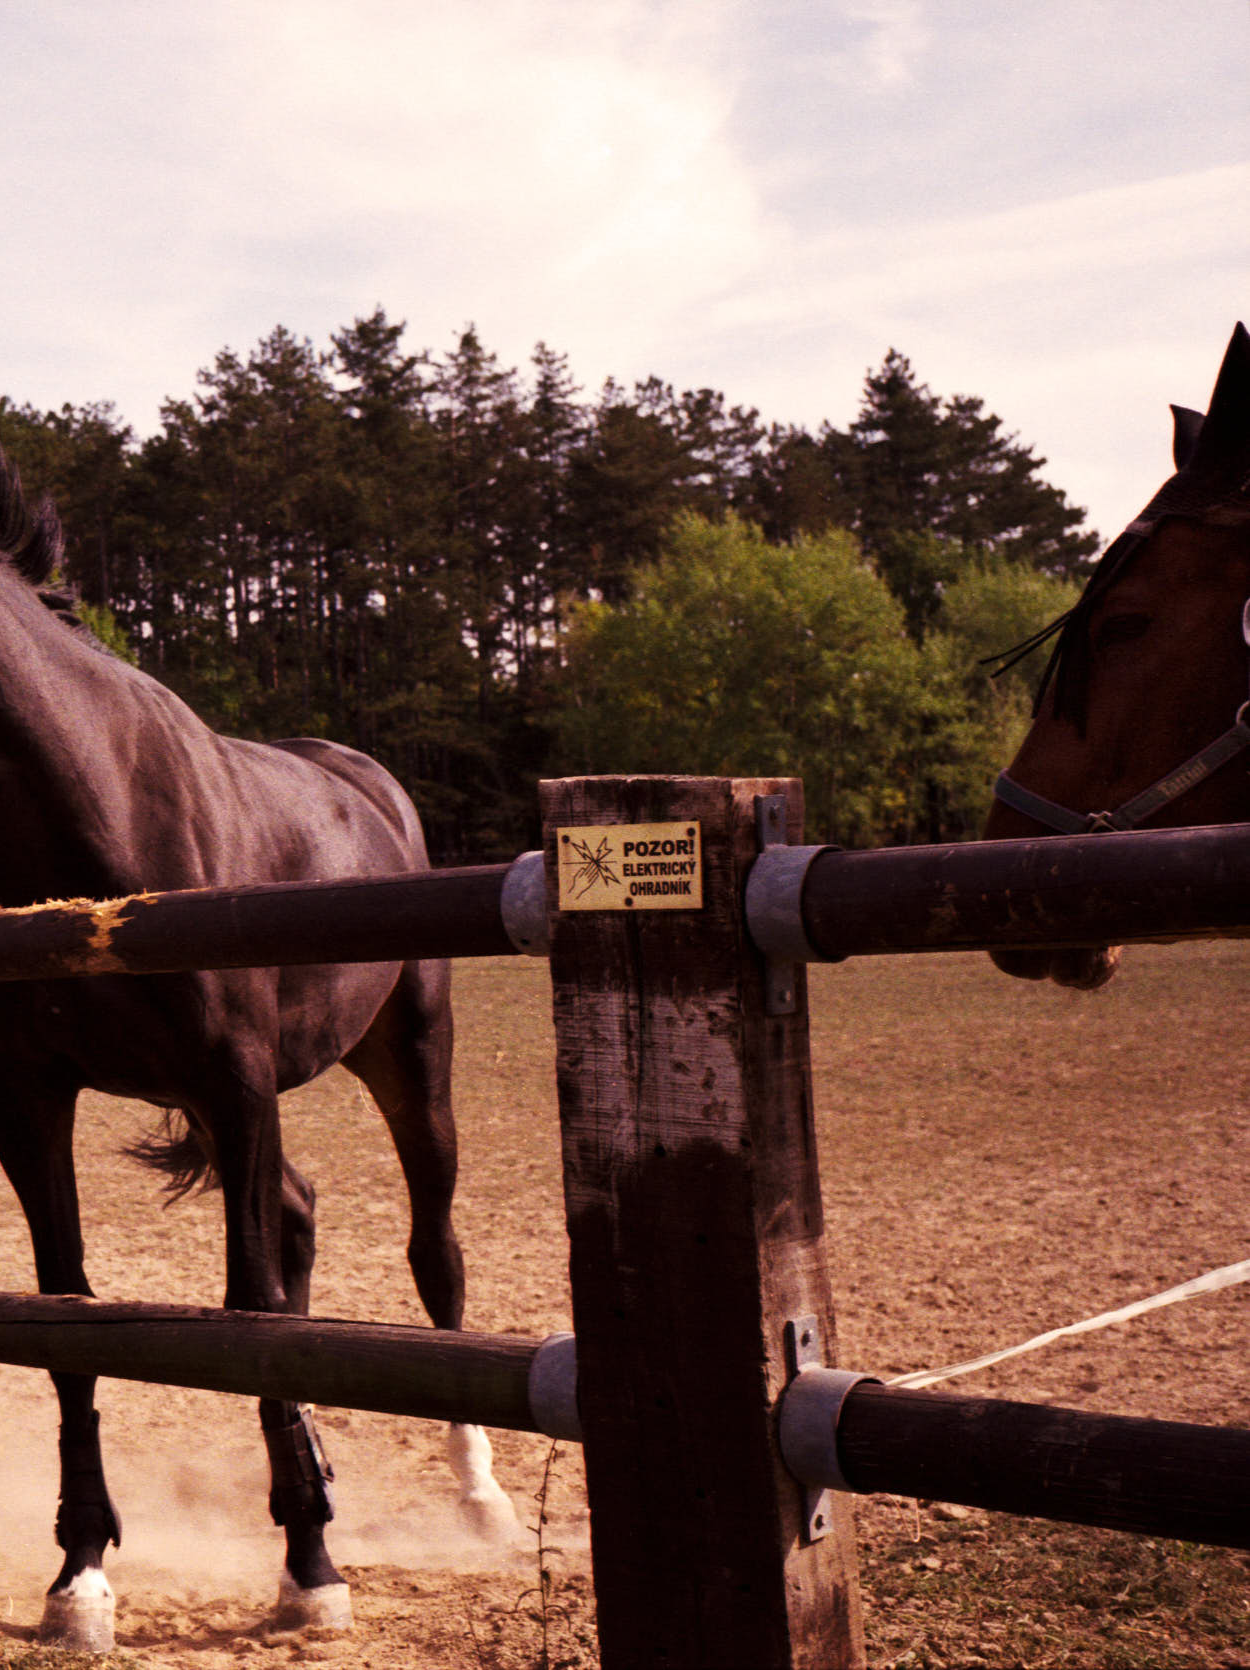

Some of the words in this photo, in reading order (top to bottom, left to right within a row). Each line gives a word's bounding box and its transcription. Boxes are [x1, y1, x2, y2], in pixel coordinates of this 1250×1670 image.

[623, 840, 695, 857] POZOR!
[622, 858, 696, 876] ELEKTRICKÝ
[630, 878, 691, 896] OHRADNÍK
